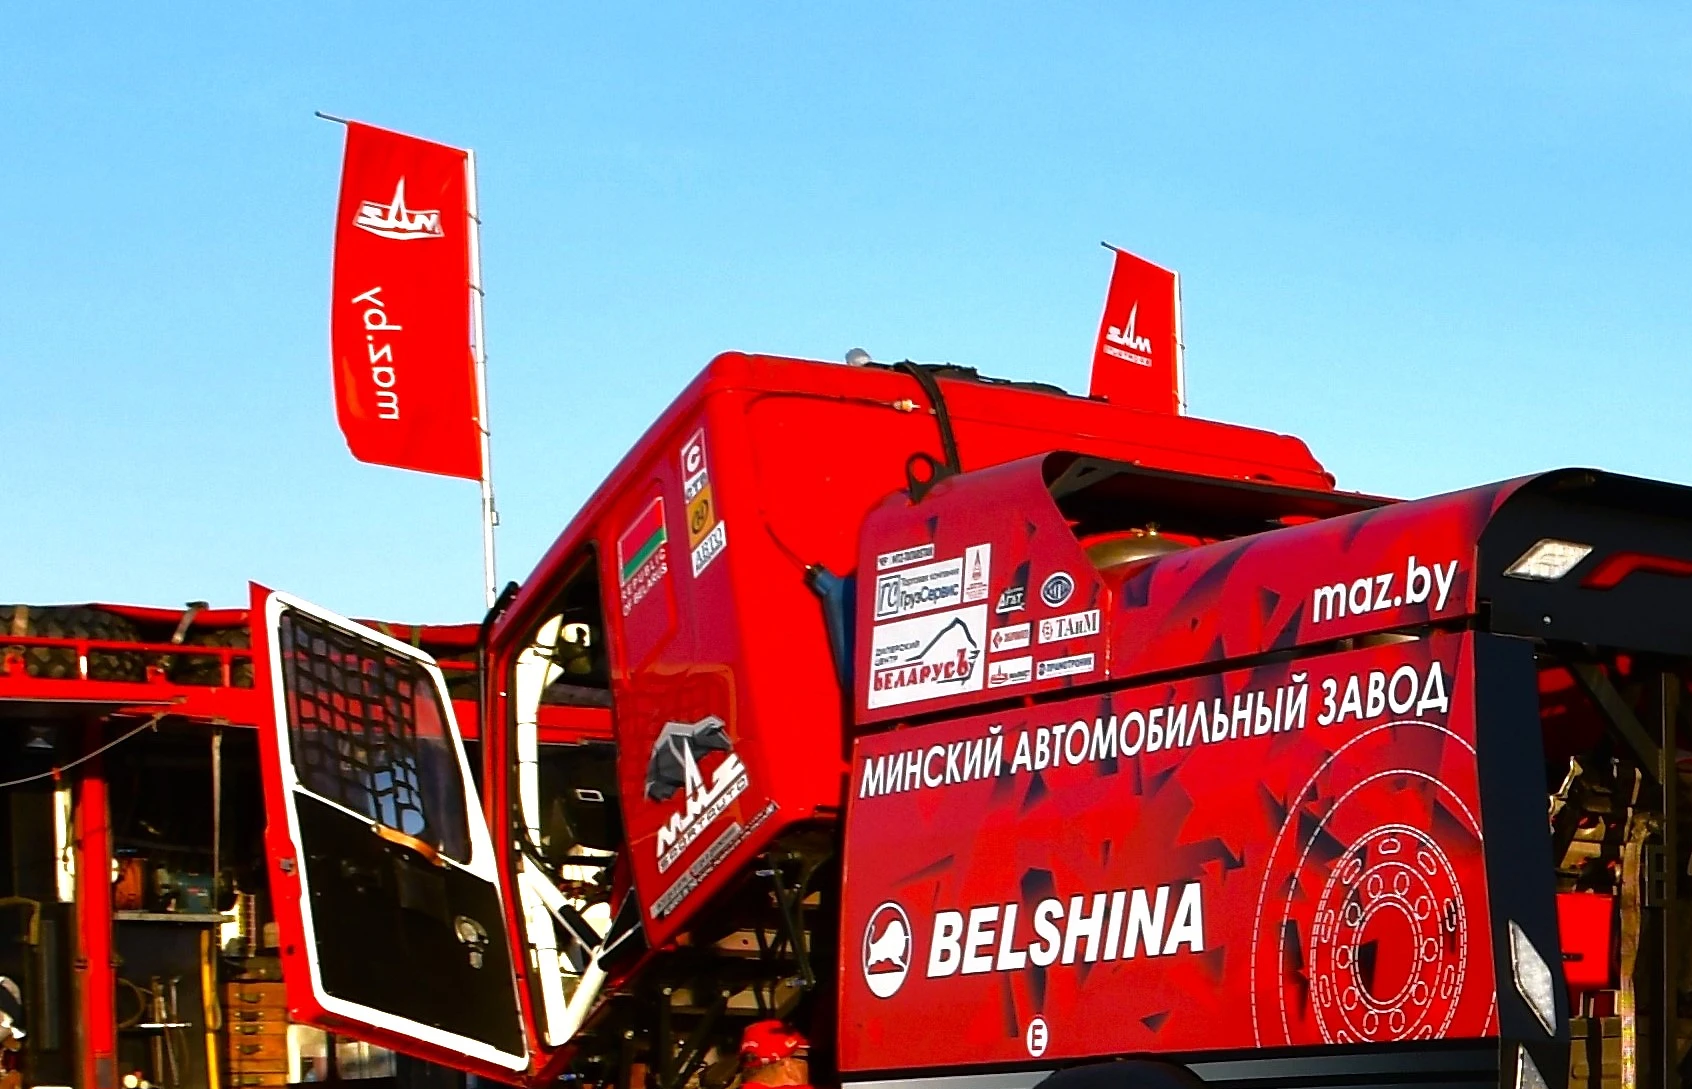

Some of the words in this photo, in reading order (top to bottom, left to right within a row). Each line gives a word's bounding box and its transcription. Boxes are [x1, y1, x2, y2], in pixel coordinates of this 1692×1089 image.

[900, 584, 960, 611] ГрузСервис
[1313, 556, 1458, 623] maz.by
[859, 726, 1003, 800] МИНСКИЙ
[1010, 672, 1311, 775] АВТОМОБИЛЬНЫЙ
[1317, 661, 1450, 727] ЗАВОД
[926, 882, 1205, 979] BELSHINA
